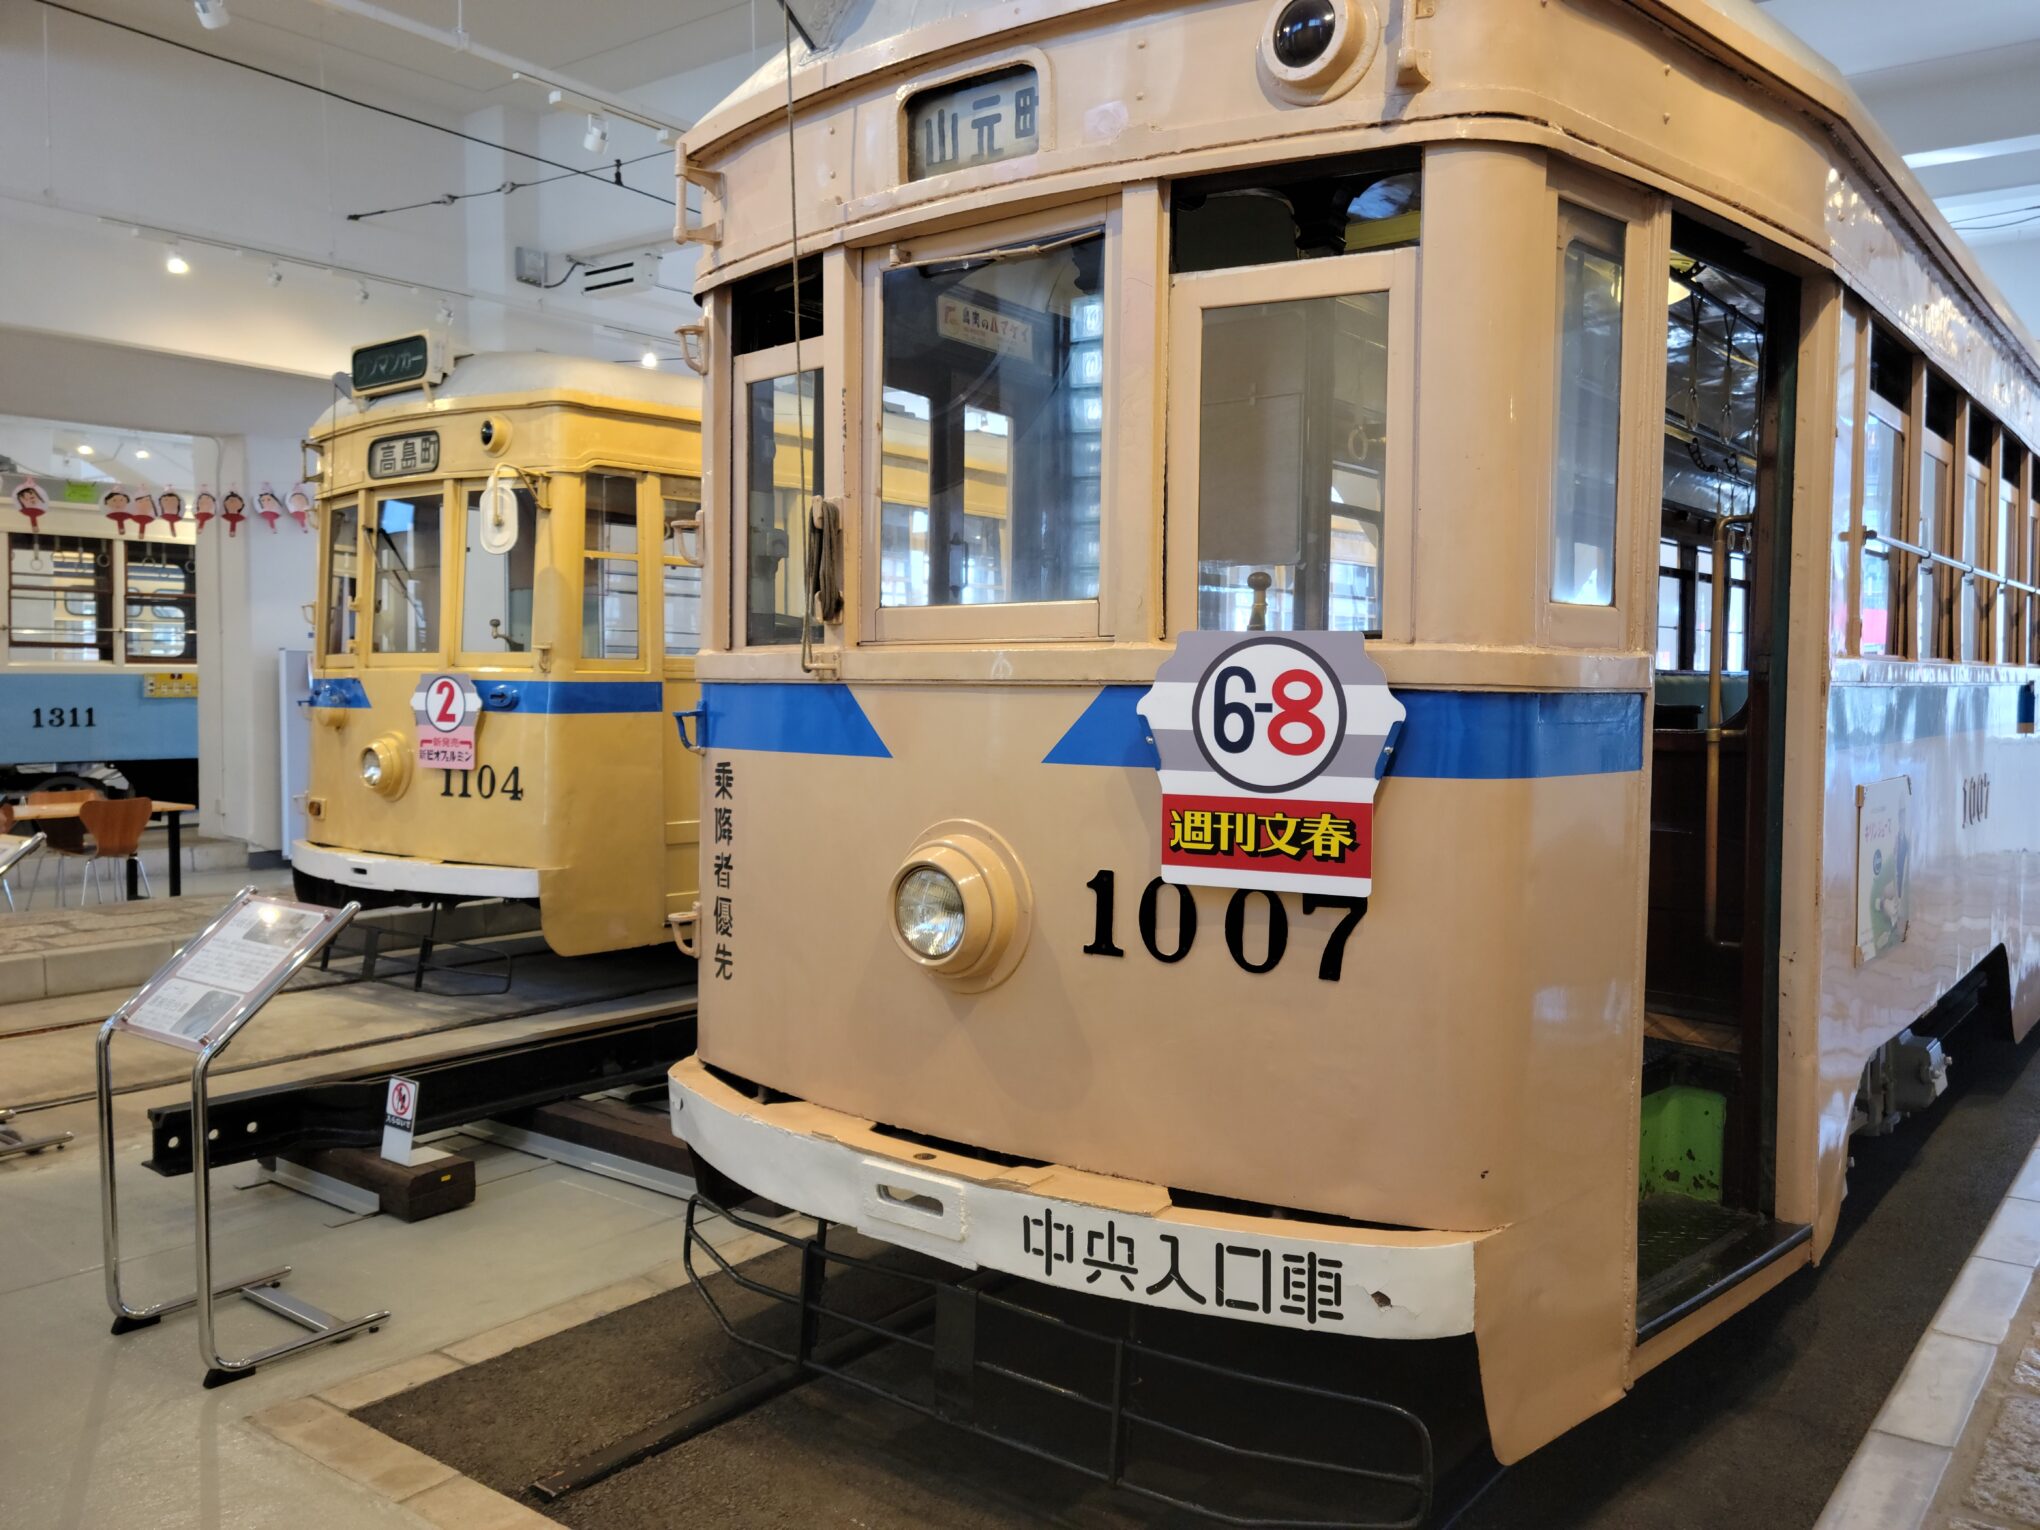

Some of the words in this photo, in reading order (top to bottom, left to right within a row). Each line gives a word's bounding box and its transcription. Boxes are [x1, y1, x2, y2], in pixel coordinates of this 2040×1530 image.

[380, 436, 439, 473] 高島町
[32, 707, 96, 728] 1311
[436, 681, 456, 722] 2
[1213, 665, 1326, 757] 6-8
[441, 764, 524, 801] 1104
[1169, 811, 1359, 861] 週刊文春
[714, 761, 735, 981] 乗降者優先
[1083, 869, 1368, 982] 1007
[1023, 1208, 1344, 1324] 中央入口車
